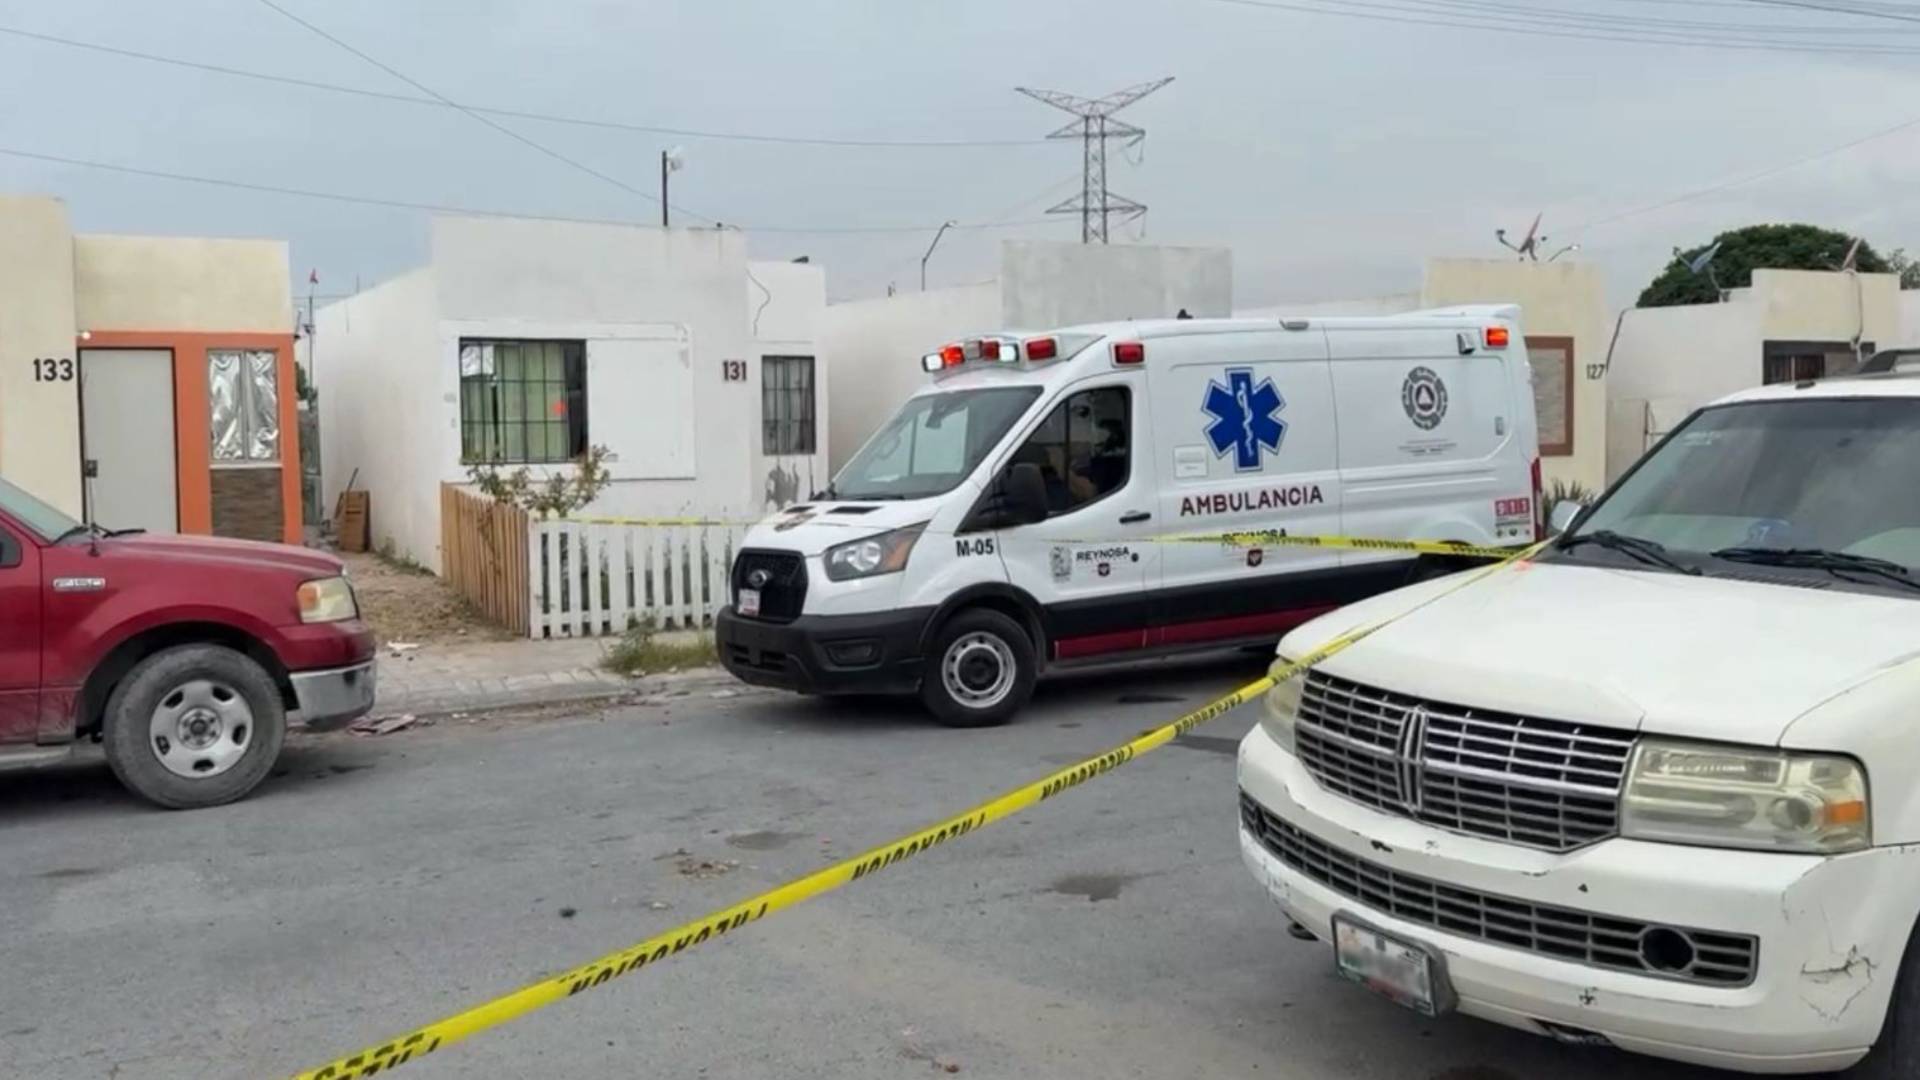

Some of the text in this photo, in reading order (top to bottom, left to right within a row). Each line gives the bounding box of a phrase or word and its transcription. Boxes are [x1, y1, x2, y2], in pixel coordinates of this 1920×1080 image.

[33, 358, 74, 382] 133
[723, 360, 747, 381] 131
[1586, 363, 1606, 380] 127
[1180, 485, 1324, 517] AMBULANCIA
[956, 538, 995, 558] M-05
[1075, 546, 1130, 562] REYNOSA
